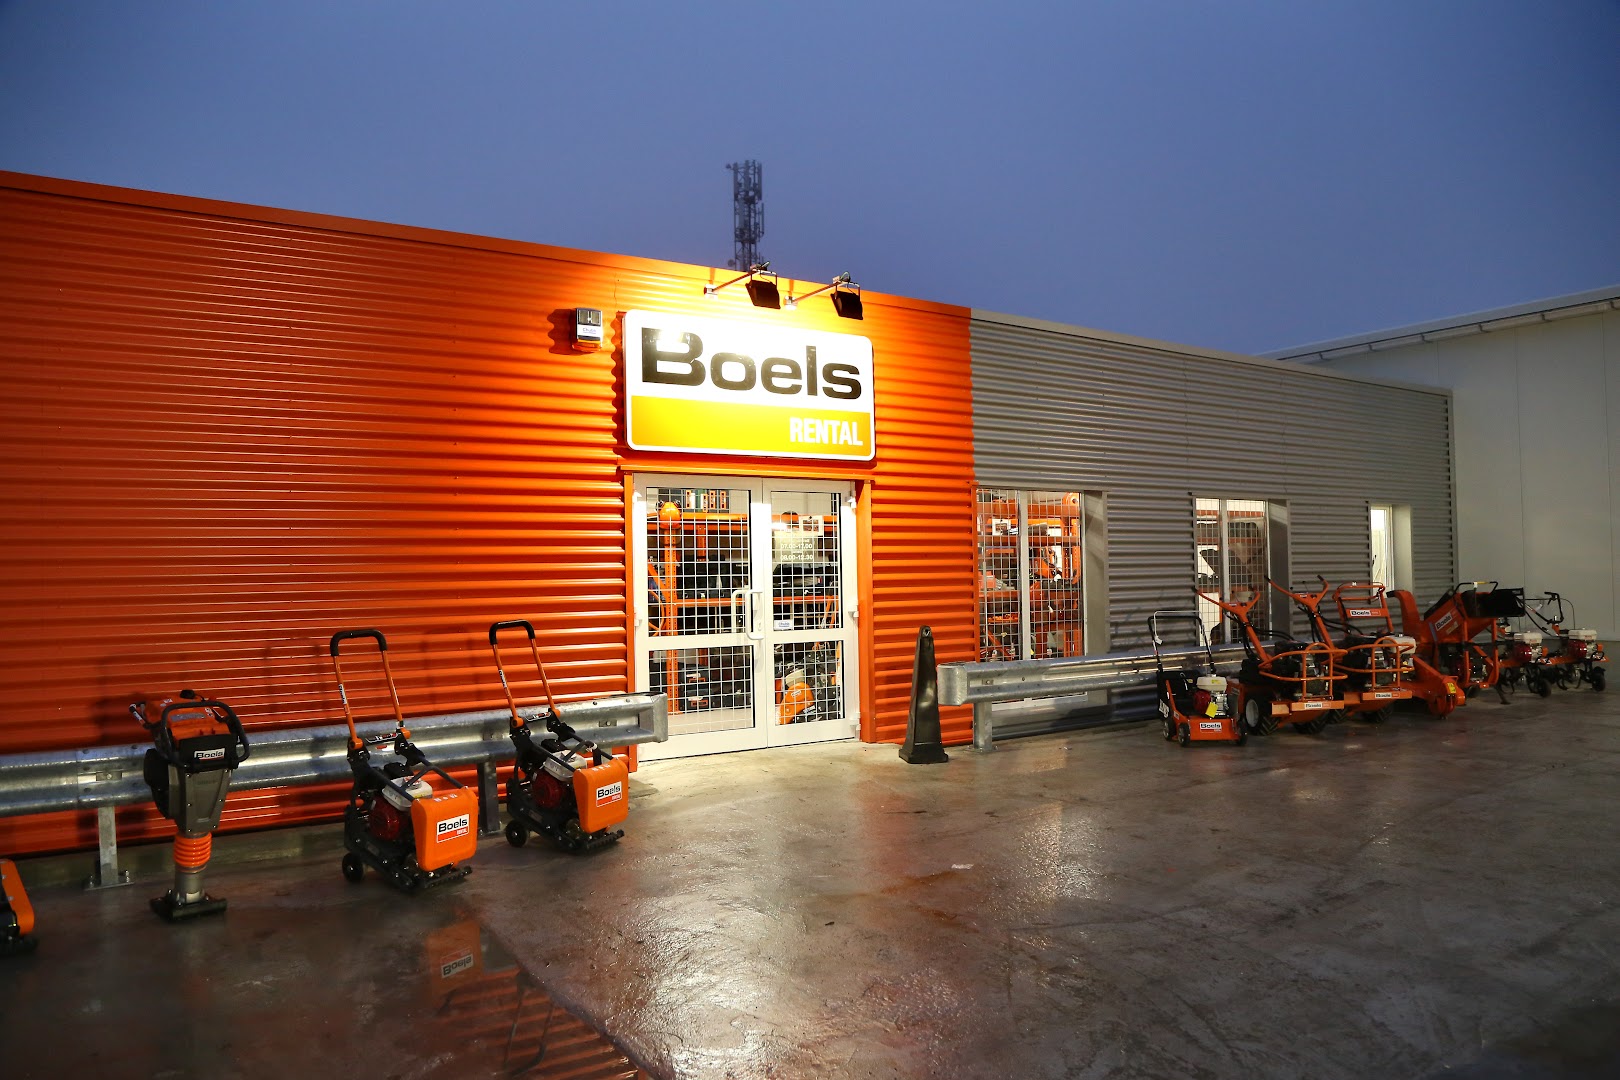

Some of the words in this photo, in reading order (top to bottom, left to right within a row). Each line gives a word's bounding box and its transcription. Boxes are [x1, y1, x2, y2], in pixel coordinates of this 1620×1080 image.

[642, 327, 862, 400] Boels
[789, 417, 864, 447] RENTAL
[196, 750, 225, 759] Boels
[597, 785, 621, 798] Boels
[438, 818, 468, 833] Boels
